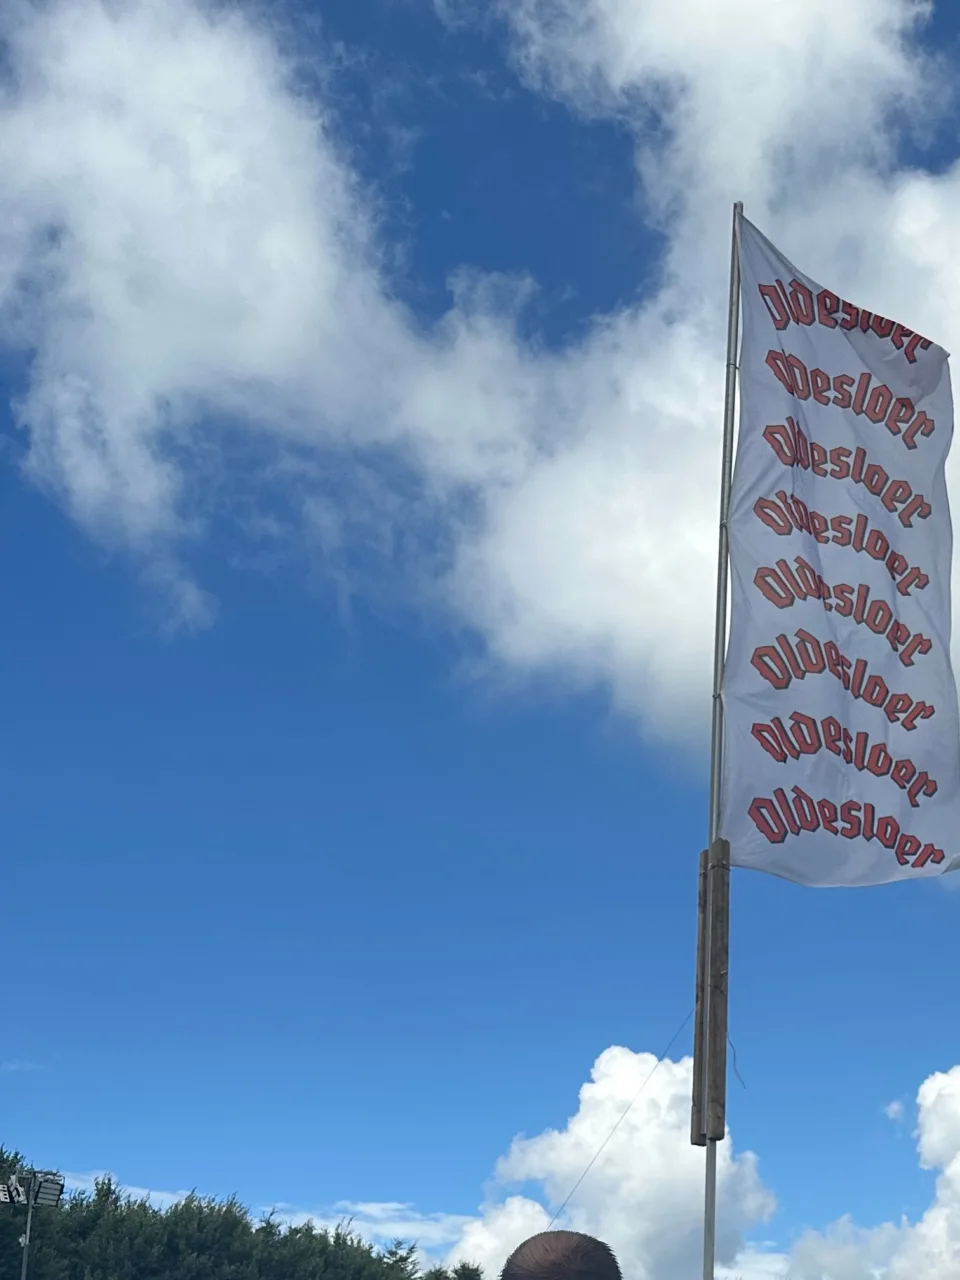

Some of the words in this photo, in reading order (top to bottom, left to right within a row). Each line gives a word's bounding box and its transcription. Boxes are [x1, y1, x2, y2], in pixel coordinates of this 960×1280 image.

[750, 628, 936, 731] Oldesloer
[751, 711, 939, 808] Oldesloer
[747, 785, 945, 869] Oldesloer
